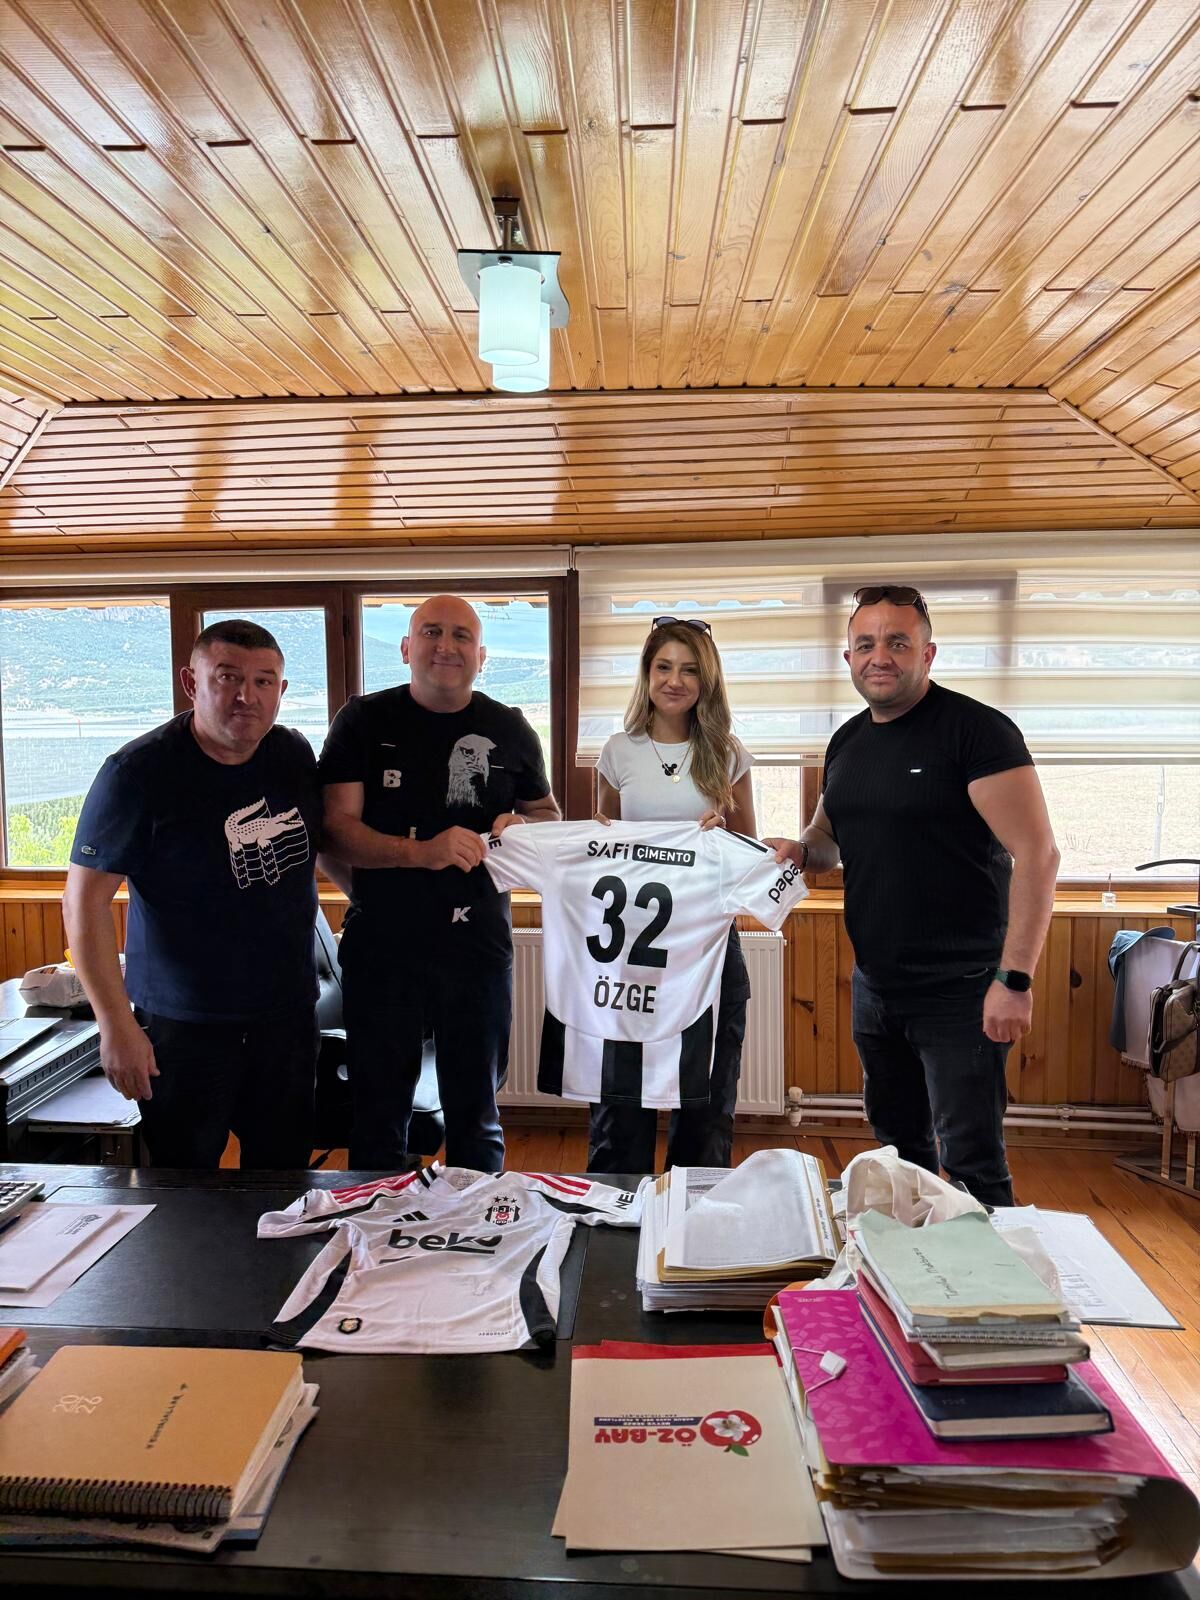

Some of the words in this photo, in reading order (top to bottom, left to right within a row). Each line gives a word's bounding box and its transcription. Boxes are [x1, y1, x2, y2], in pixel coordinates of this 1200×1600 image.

[636, 846, 692, 864] ÇİMENTO
[451, 905, 472, 923] K
[586, 875, 673, 969] 32
[593, 975, 657, 1014] ÖZGE
[388, 1228, 503, 1255] beko
[594, 1428, 697, 1447] ÖZ-BAY
